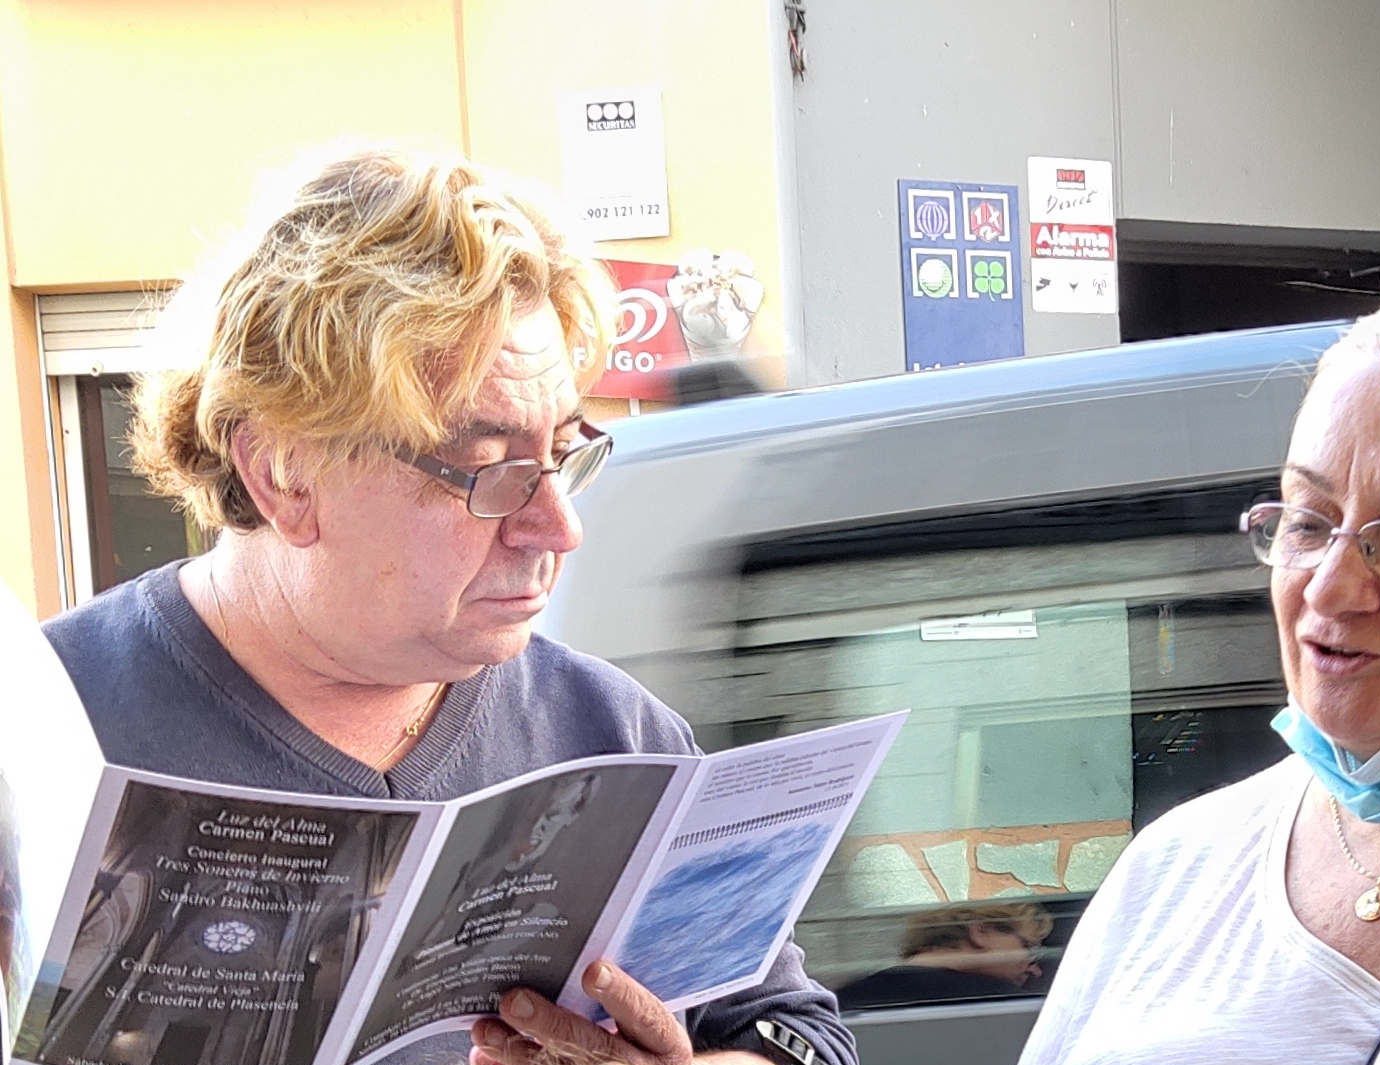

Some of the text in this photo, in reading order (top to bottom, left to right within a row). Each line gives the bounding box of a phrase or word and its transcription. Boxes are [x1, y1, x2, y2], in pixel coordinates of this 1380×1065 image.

[587, 203, 660, 219] 902 121 122
[573, 346, 655, 373] FIGO
[199, 820, 335, 847] Carmen Pascual
[217, 809, 327, 834] Luz del Alma
[155, 854, 190, 872] Tres
[261, 868, 282, 882] de
[187, 845, 329, 870] Concierto Inaugural
[225, 880, 269, 896] Piano
[120, 956, 188, 978] Catedral
[191, 967, 211, 979] de
[214, 968, 257, 981] Santa
[137, 990, 204, 1008] Catedral
[207, 997, 226, 1010] de
[230, 999, 299, 1011] Plasencia
